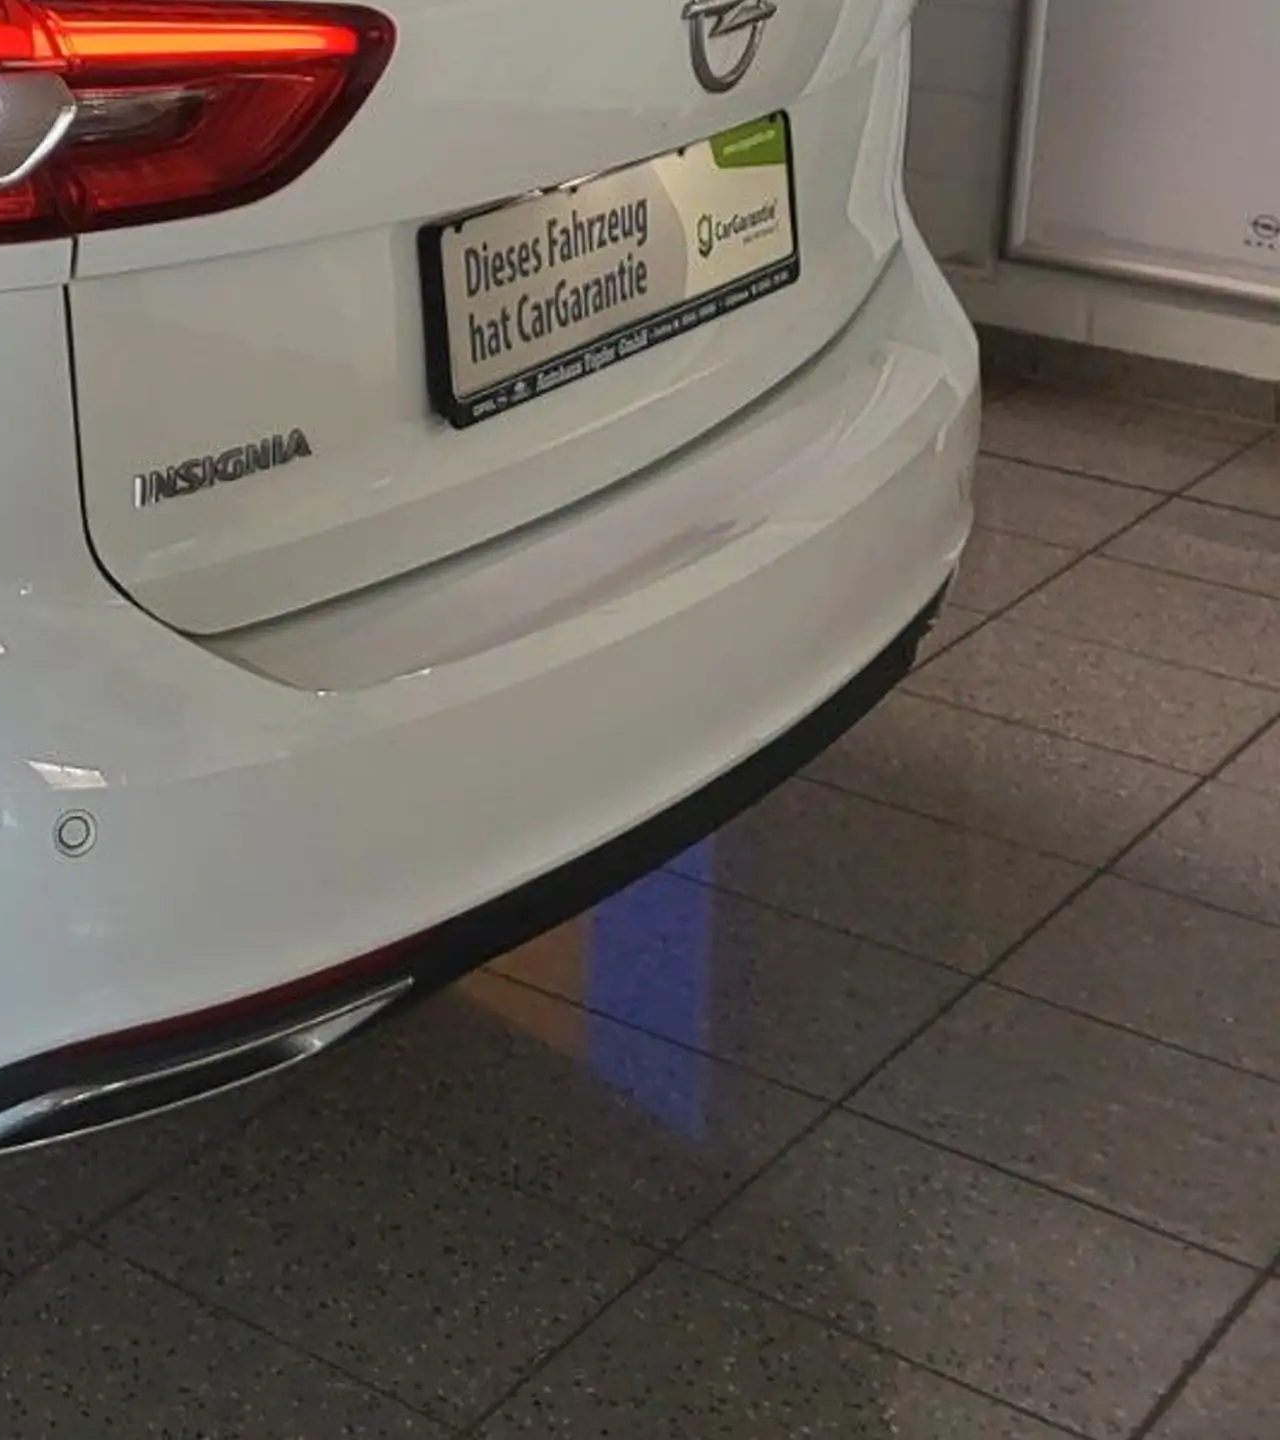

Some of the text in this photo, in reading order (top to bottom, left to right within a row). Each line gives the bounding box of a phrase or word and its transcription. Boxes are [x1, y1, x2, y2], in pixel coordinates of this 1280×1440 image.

[464, 198, 648, 298] Dieses Fahrzeug
[468, 307, 513, 364] hat
[516, 252, 648, 343] CarGarantie
[134, 426, 313, 510] INSIGNIA
